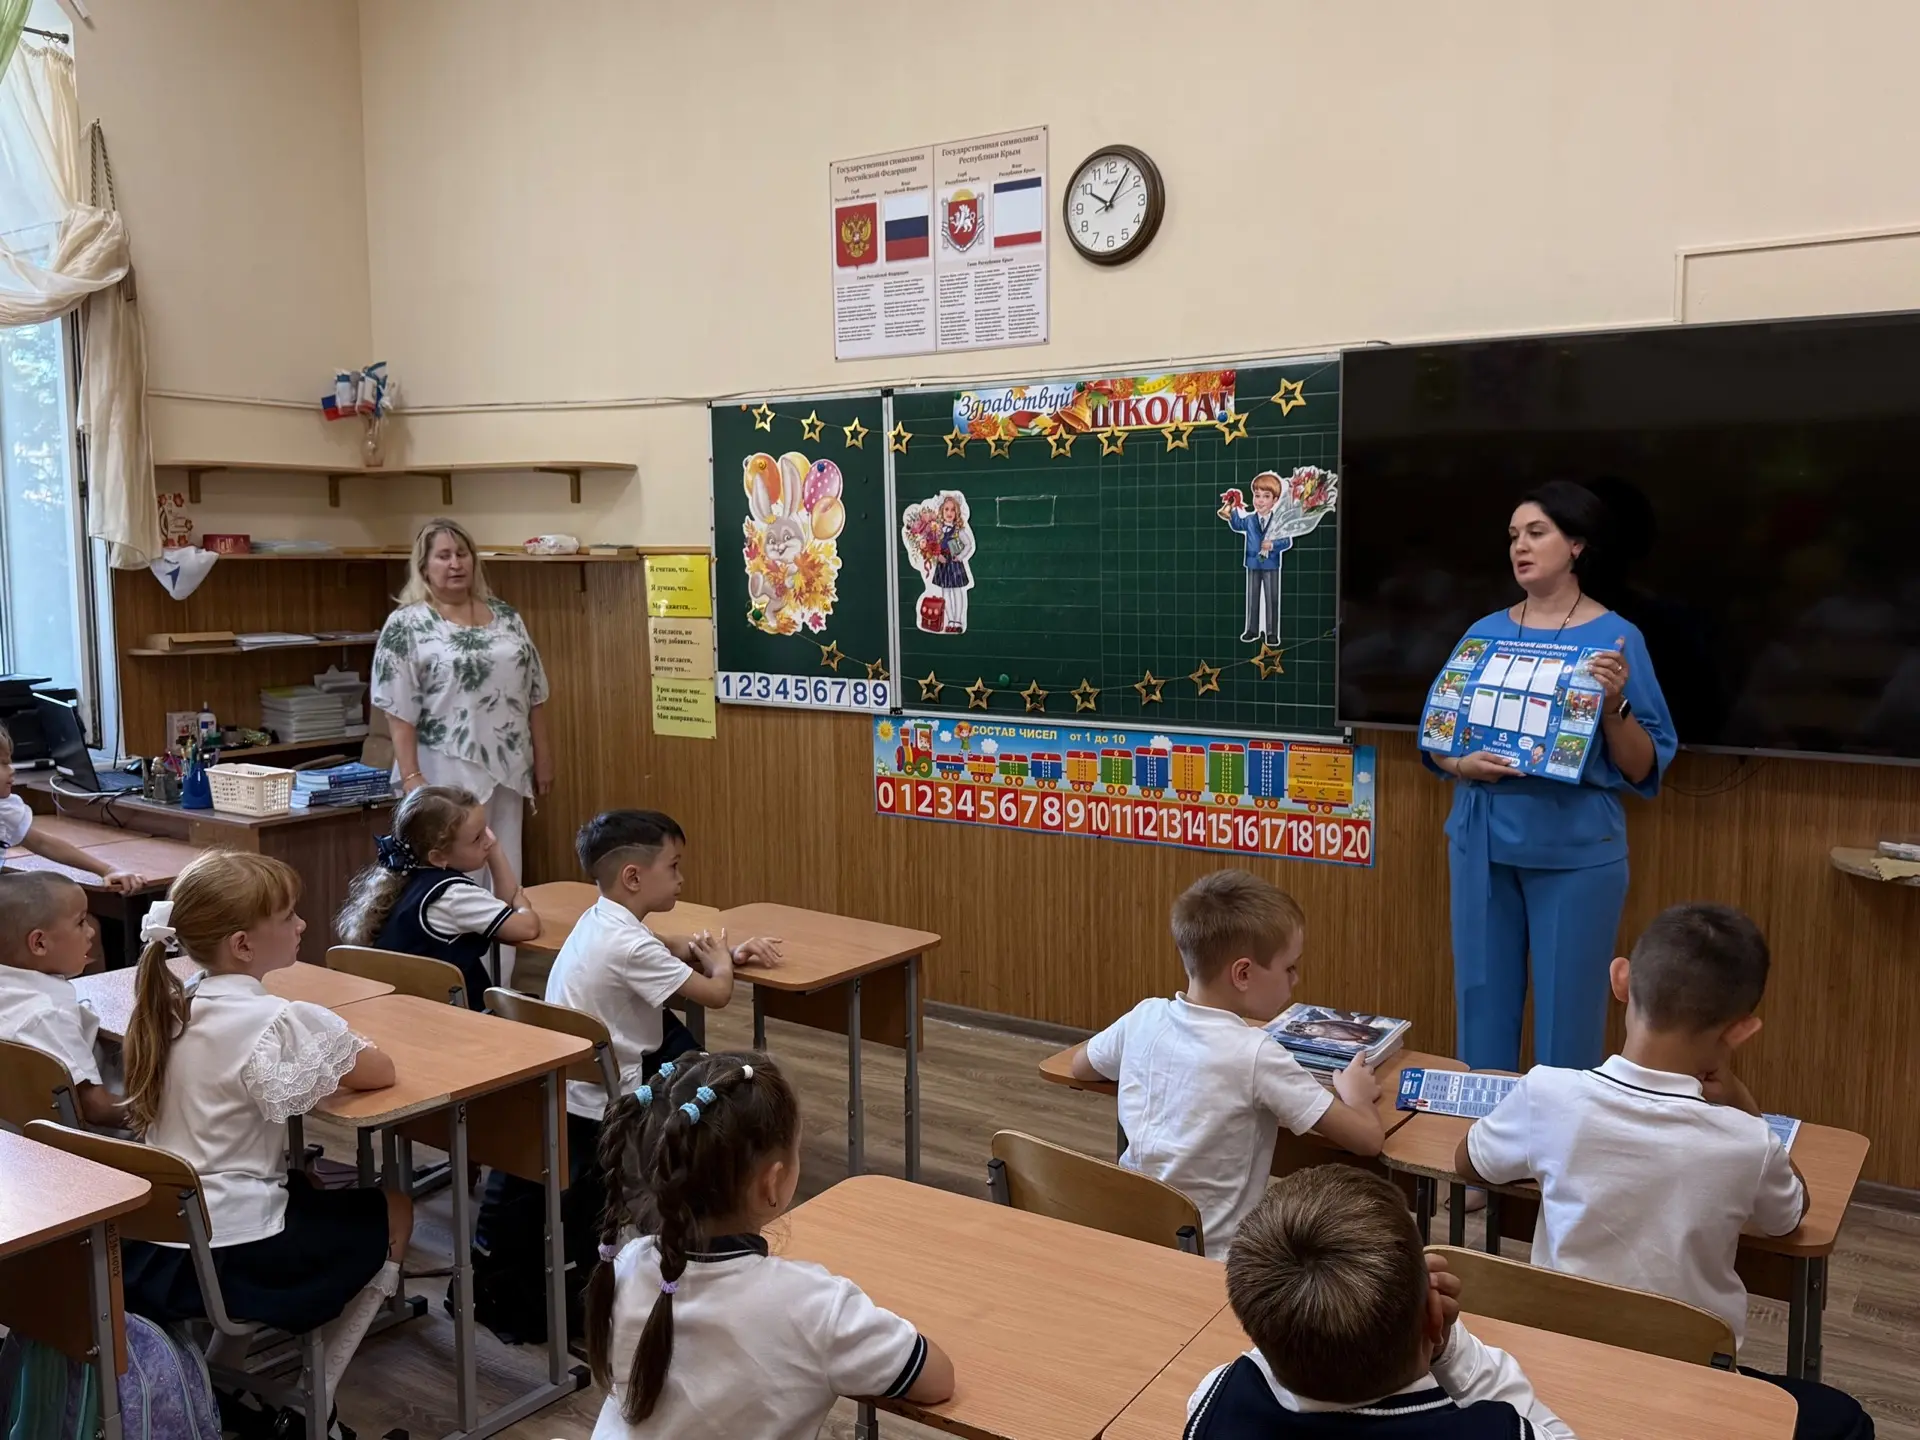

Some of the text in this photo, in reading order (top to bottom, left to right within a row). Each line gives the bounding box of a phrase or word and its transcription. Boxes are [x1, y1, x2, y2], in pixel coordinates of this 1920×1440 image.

[942, 134, 1039, 157] Государственная символика
[958, 148, 1021, 164] Республики Крым
[836, 154, 925, 174] Государственная символика
[1104, 161, 1117, 174] 12
[844, 166, 917, 183] Российской Федерации
[1092, 168, 1101, 180] 11
[1133, 176, 1141, 187] 2
[1081, 183, 1093, 196] 10
[1138, 194, 1145, 206] 3
[1076, 203, 1084, 215] 9
[1133, 213, 1141, 225] 4
[1081, 220, 1088, 232] 8
[1093, 232, 1100, 244] 7
[1121, 228, 1129, 240] 5
[1107, 235, 1114, 247] 6
[959, 386, 1074, 421] Здравствуй
[722, 675, 887, 706] 1 2 3 4 5 6 7 8 9
[973, 725, 1016, 737] СОСТАВ
[1019, 729, 1057, 740] ЧИСЕЛ
[1085, 733, 1090, 742] 1
[1095, 734, 1108, 744] до
[1112, 734, 1126, 744] 10
[878, 782, 1370, 859] 0 1 2 3 4 5 6 7 8 9 10 11 12 13 14 15 16 17 18 19 20
